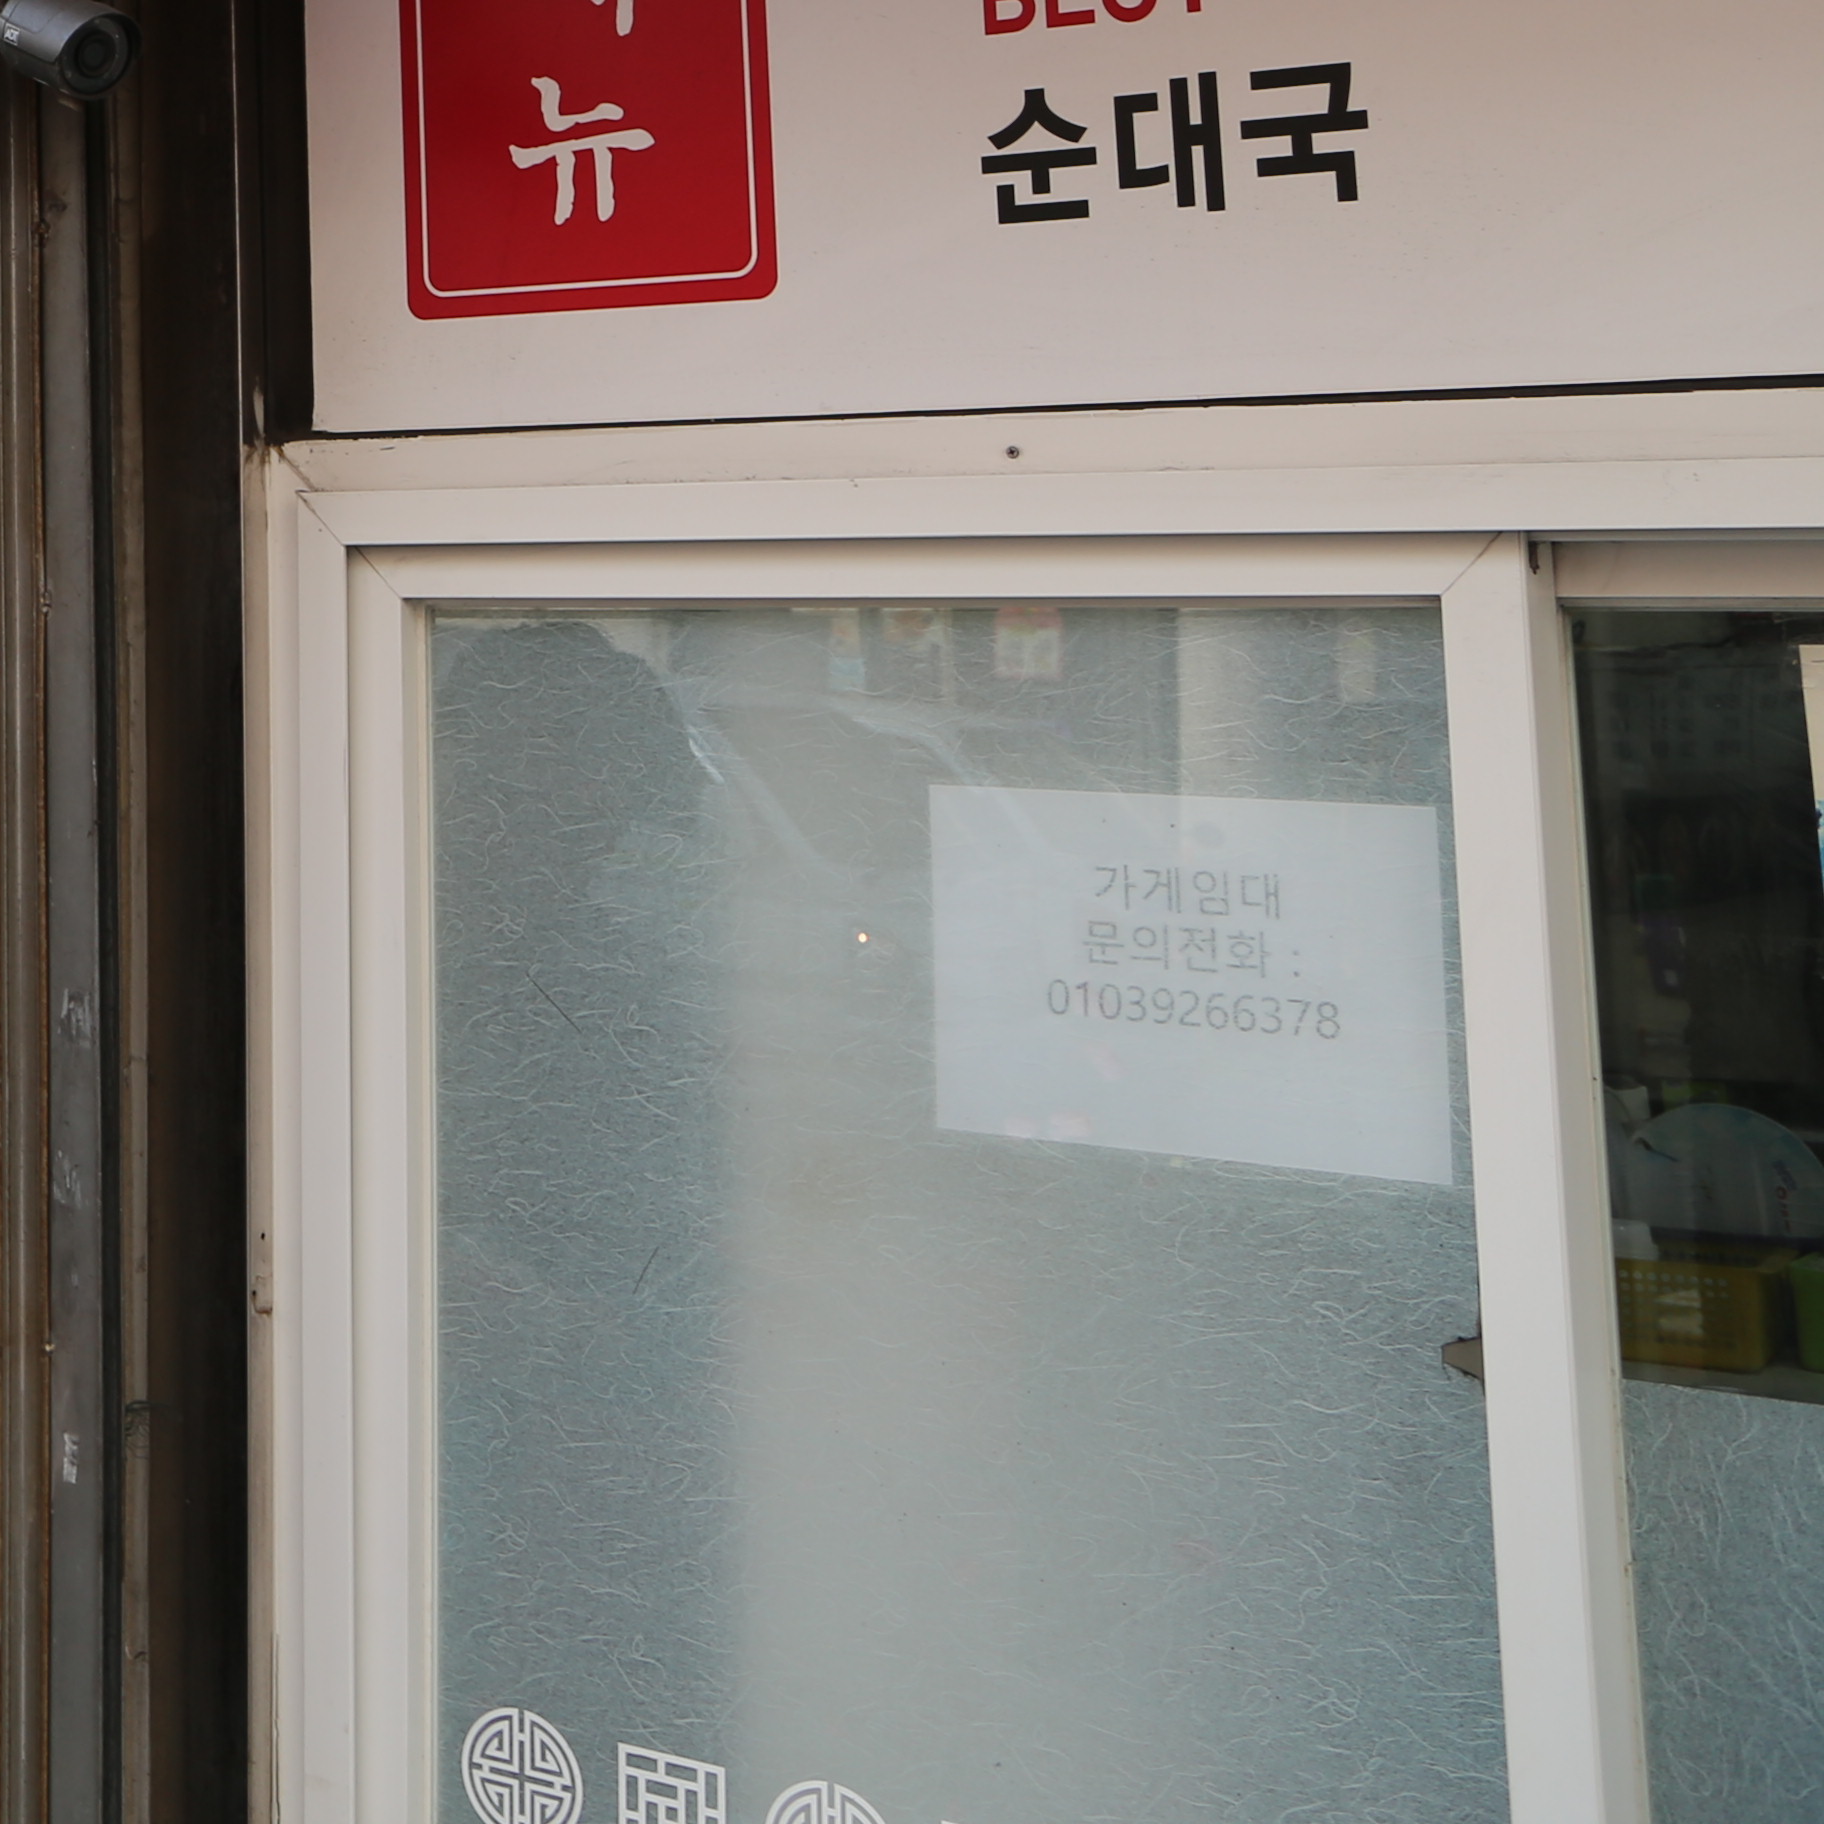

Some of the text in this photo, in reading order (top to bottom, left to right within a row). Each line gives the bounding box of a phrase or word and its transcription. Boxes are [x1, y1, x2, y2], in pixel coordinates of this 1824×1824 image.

[979, 62, 1369, 224] 순대국
[1095, 864, 1282, 920] 가게임대
[1082, 920, 1269, 979] 문의전화
[1046, 979, 1342, 1042] 01039266378
